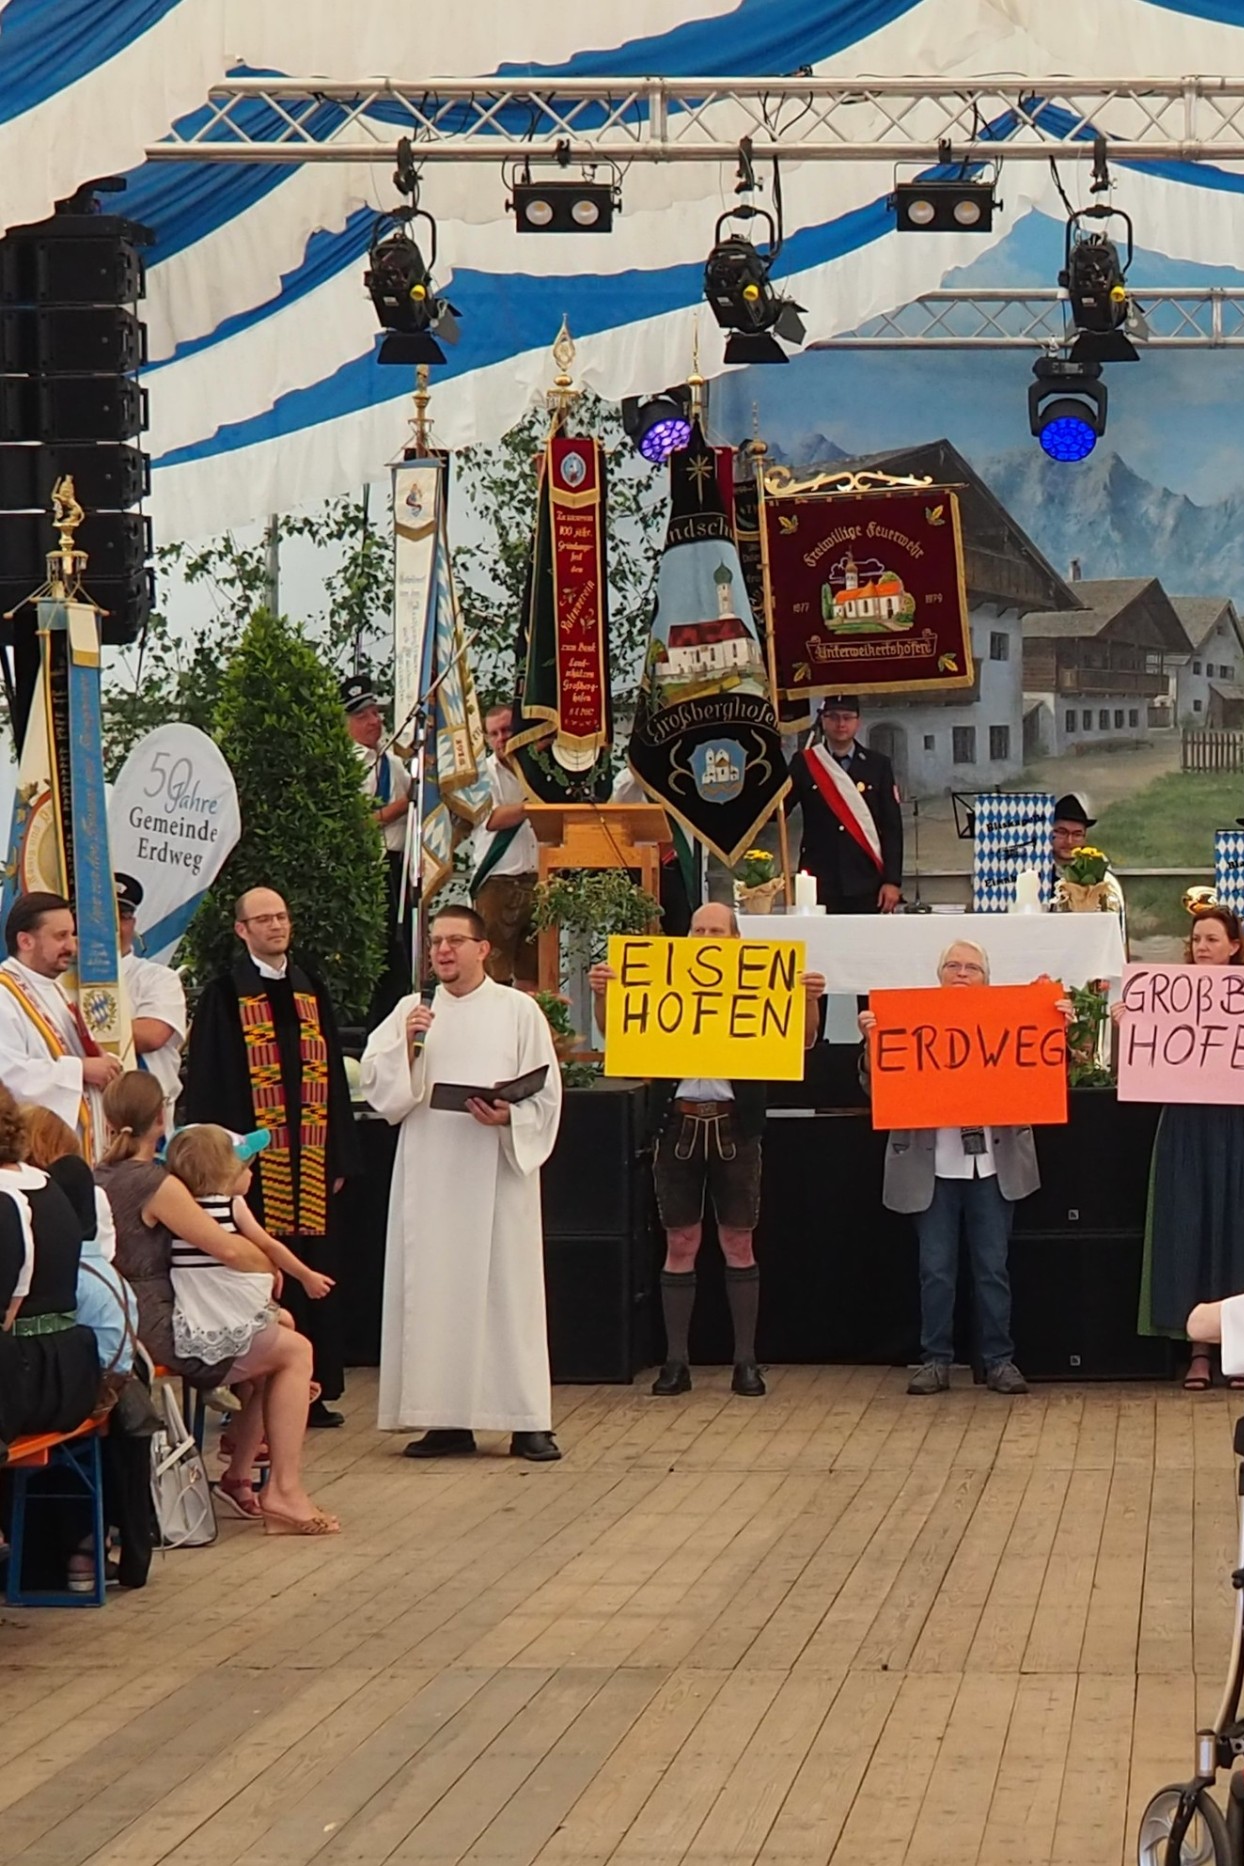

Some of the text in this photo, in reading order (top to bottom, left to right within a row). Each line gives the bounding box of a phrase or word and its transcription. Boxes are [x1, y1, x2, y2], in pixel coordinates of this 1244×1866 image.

[666, 516, 734, 545] ndsch
[803, 524, 863, 568] Freiwillige
[866, 520, 925, 560] Feuerwehr
[143, 752, 218, 814] 50 Jahre
[129, 806, 218, 842] Gemeinde
[136, 836, 203, 876] Erdweg
[623, 991, 793, 1038] HOFEN
[877, 1024, 1064, 1072] ERDWEG
